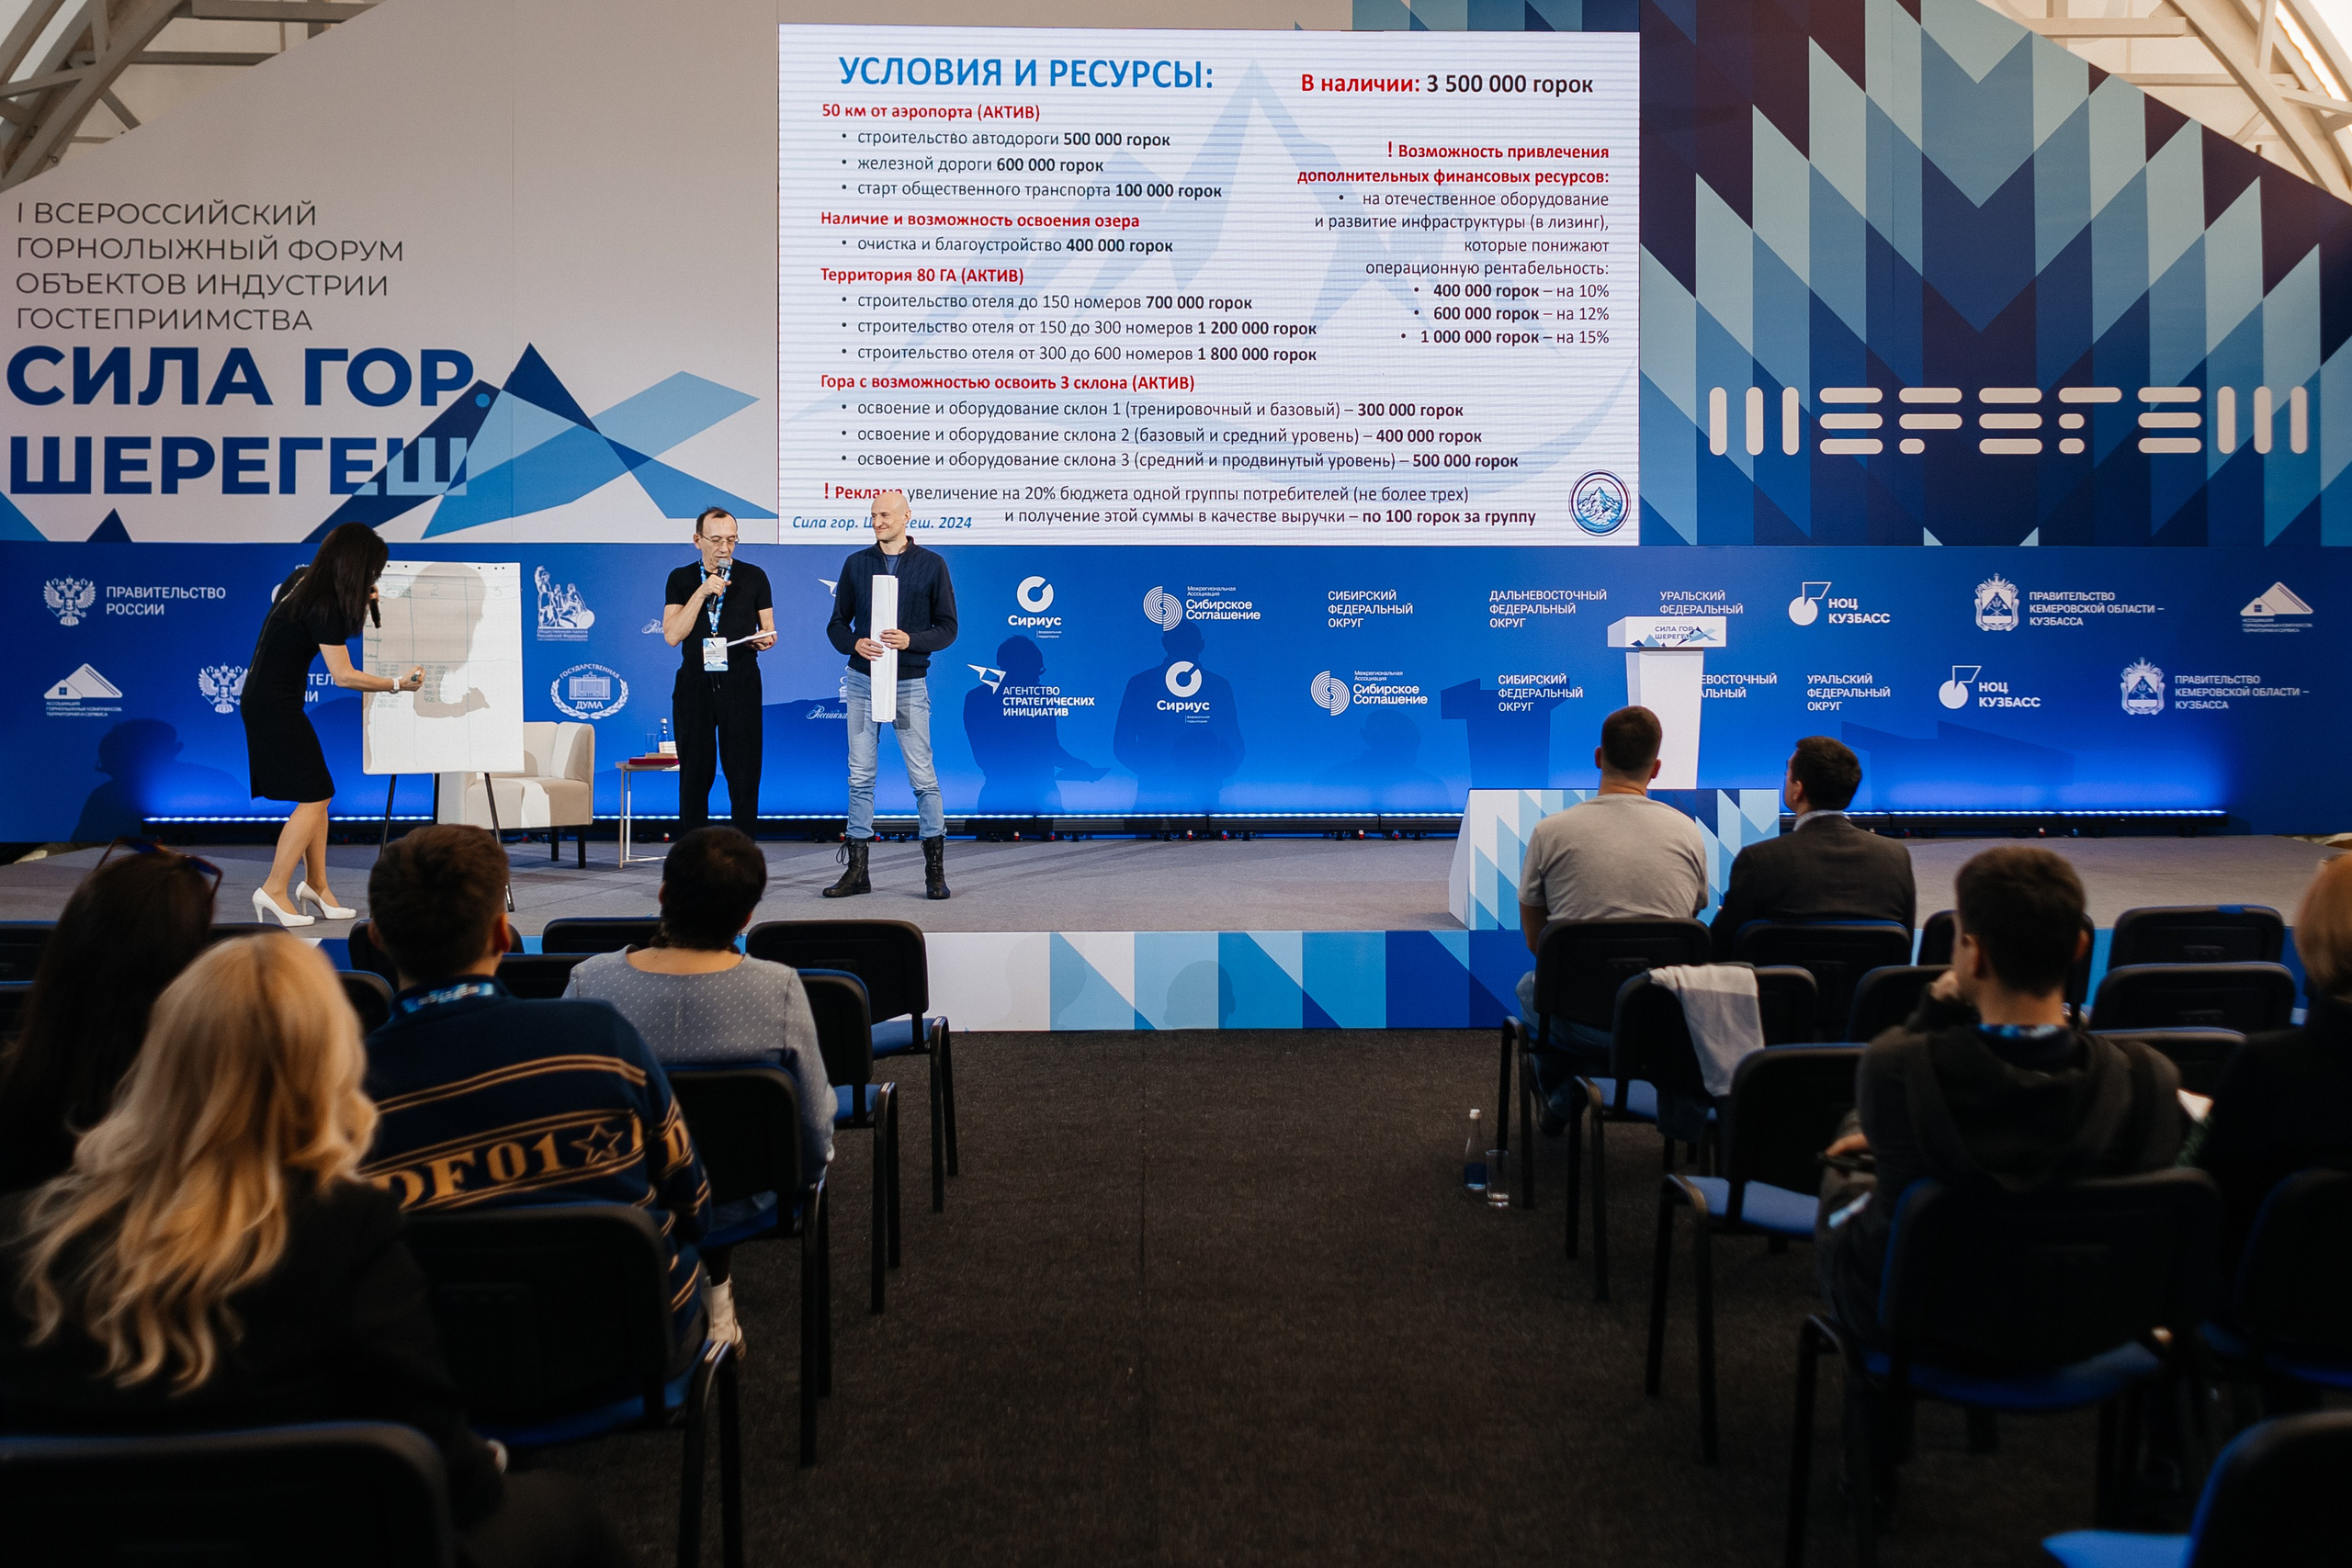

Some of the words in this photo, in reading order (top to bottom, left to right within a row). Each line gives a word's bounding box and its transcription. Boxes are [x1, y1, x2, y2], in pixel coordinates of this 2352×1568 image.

[838, 56, 1001, 86] УСЛОВИЯ
[1014, 59, 1037, 87] И
[1049, 59, 1213, 89] РЕСУРСЫ:
[1301, 73, 1315, 92] В
[1321, 77, 1420, 93] наличии:
[1427, 73, 1439, 93] 3
[1445, 74, 1483, 93] 500
[1488, 74, 1527, 94] 000
[1533, 78, 1594, 98] горок
[822, 103, 841, 118] 50
[844, 107, 866, 117] км
[870, 107, 888, 118] от
[891, 107, 973, 122] аэропорта
[977, 104, 1040, 122] (АКТИВ)
[857, 132, 967, 147] строительство
[972, 133, 1059, 149] автодороги
[1063, 132, 1091, 146] 500
[1094, 132, 1123, 146] 000
[1126, 135, 1170, 150] горок
[1398, 144, 1504, 159] Возможность
[1507, 147, 1610, 162] привлечения
[1296, 171, 1430, 186] дополнительных
[1433, 168, 1531, 186] финансовых
[1534, 172, 1610, 186] ресурсов:
[1363, 194, 1380, 206] на
[1385, 194, 1496, 206] отечественное
[1500, 191, 1609, 209] оборудование
[34, 198, 316, 226] ВСЕРОССИЙСКИЙ
[820, 211, 889, 226] Наличие
[893, 215, 903, 225] и
[908, 215, 1013, 227] возможность
[1016, 216, 1091, 228] освоения
[1094, 216, 1140, 231] озера
[1315, 217, 1324, 228] и
[1329, 217, 1397, 231] развитие
[1401, 213, 1525, 232] инфраструктуры
[1530, 214, 1544, 231] (в
[1547, 214, 1609, 232] лизинг),
[17, 234, 277, 261] ГОРНОЛЫЖНЫЙ
[288, 239, 402, 262] ФОРУМ
[857, 239, 917, 251] очистка
[922, 240, 931, 251] и
[935, 236, 1062, 255] благоустройство
[1066, 238, 1094, 253] 400
[1097, 238, 1125, 253] 000
[1129, 241, 1173, 256] горок
[1464, 241, 1527, 255] которые
[1532, 241, 1610, 253] понижают
[1365, 263, 1480, 278] операционную
[1484, 260, 1609, 278] рентабельность:
[820, 267, 912, 285] Территория
[917, 267, 936, 282] 80
[940, 268, 957, 282] ГА
[961, 267, 1024, 286] (АКТИВ)
[16, 272, 187, 295] ОБЪЕКТОВ
[197, 273, 387, 299] ИНДУСТРИИ
[1433, 283, 1461, 298] 400
[1464, 283, 1492, 298] 000
[1496, 287, 1540, 301] горок
[1556, 287, 1574, 298] на
[1579, 284, 1610, 298] 10%
[17, 307, 313, 331] ГОСТЕПРИИМСТВА
[6, 345, 274, 406] СИЛА
[304, 347, 474, 407] ГОР
[820, 375, 855, 392] Гора
[859, 377, 867, 389] с
[871, 378, 990, 389] возможностью
[994, 378, 1057, 389] освоить
[1060, 375, 1069, 389] 3
[1073, 378, 1127, 389] склона
[1132, 374, 1195, 393] (АКТИВ)
[857, 403, 931, 415] освоение
[935, 404, 944, 414] и
[949, 400, 1059, 419] оборудование
[1063, 404, 1108, 416] склон
[1113, 401, 1121, 415] 1
[1125, 400, 1252, 420] (тренировочный
[1257, 405, 1265, 416] и
[1270, 401, 1340, 420] базовый)
[1357, 402, 1385, 417] 300
[1388, 402, 1416, 417] 000
[1420, 406, 1464, 421] горок
[10, 436, 468, 496] ШЕРЕГЕШ
[907, 488, 998, 503] увеличение
[1002, 489, 1020, 501] на
[1024, 486, 1057, 501] 20%
[1060, 485, 1128, 503] бюджета
[1133, 485, 1181, 503] одной
[1185, 489, 1238, 503] группы
[1243, 486, 1349, 504] потребителей
[1353, 486, 1377, 503] (не
[1381, 486, 1427, 502] более
[1430, 486, 1469, 504] трех)
[793, 515, 827, 529] Сила
[831, 520, 859, 531] гор.
[939, 516, 972, 529] 2024
[107, 587, 226, 599] ПРАВИТЕЛЬСТВО
[1328, 589, 1396, 601] СИБИРСКИЙ
[1488, 589, 1607, 602] ДАЛЬНЕВОСТОЧНЫЙ
[1659, 589, 1725, 601] УРАЛЬСКИЙ
[2030, 592, 2115, 601] ПРАВИТЕЛЬСТВО
[107, 604, 164, 615] РОССИИ
[1185, 599, 1253, 611] Сибирское
[1328, 603, 1413, 616] ФЕДЕРАЛЬНЫЙ
[1489, 602, 1576, 615] ФЕДЕРАЛЬНЫЙ
[1659, 603, 1744, 615] ФЕДЕРАЛЬНЫЙ
[1828, 598, 1859, 611] НОЦ
[2030, 603, 2105, 614] КЕМЕРОВСКОЙ
[2107, 604, 2154, 614] ОБЛАСТИ
[1008, 615, 1062, 628] Сириус
[1185, 609, 1261, 621] Соглашение
[1828, 613, 1891, 624] КУЗБАСС
[2030, 616, 2084, 626] КУЗБАССА
[1328, 617, 1364, 628] ОКРУГ
[1489, 617, 1526, 628] ОКРУГ
[559, 663, 620, 680] ГОСУДАРСТВЕННАЯ
[1807, 672, 1872, 684] УРАЛЬСКИЙ
[1498, 672, 1566, 685] СИБИРСКИЙ
[1702, 672, 1778, 685] ЕВОСТОЧНЫЙ
[2176, 675, 2259, 684] ПРАВИТЕЛЬСТВО
[1002, 686, 1060, 695] АГЕНТСТВО
[1352, 683, 1419, 695] Сибирское
[1498, 686, 1583, 700] ФЕДЕРАЛЬНЫЙ
[1807, 686, 1891, 699] ФЕДЕРАЛЬНЫЙ
[1978, 682, 2009, 694] НОЦ
[2176, 688, 2250, 697] КЕМЕРОВСКОЙ
[2252, 687, 2300, 697] ОБЛАСТИ
[574, 701, 605, 711] ДУМА
[1002, 696, 1095, 706] СТРАТЕГИЧЕСКИХ
[1157, 699, 1210, 713] Сириус
[1352, 694, 1429, 705] Соглашение
[1807, 701, 1842, 711] ОКРУГ
[1979, 696, 2041, 707] КУЗБАСС
[2176, 700, 2229, 709] КУЗБАССА
[1003, 707, 1069, 718] ИНИЦИАТИВ
[1498, 702, 1534, 712] ОКРУГ
